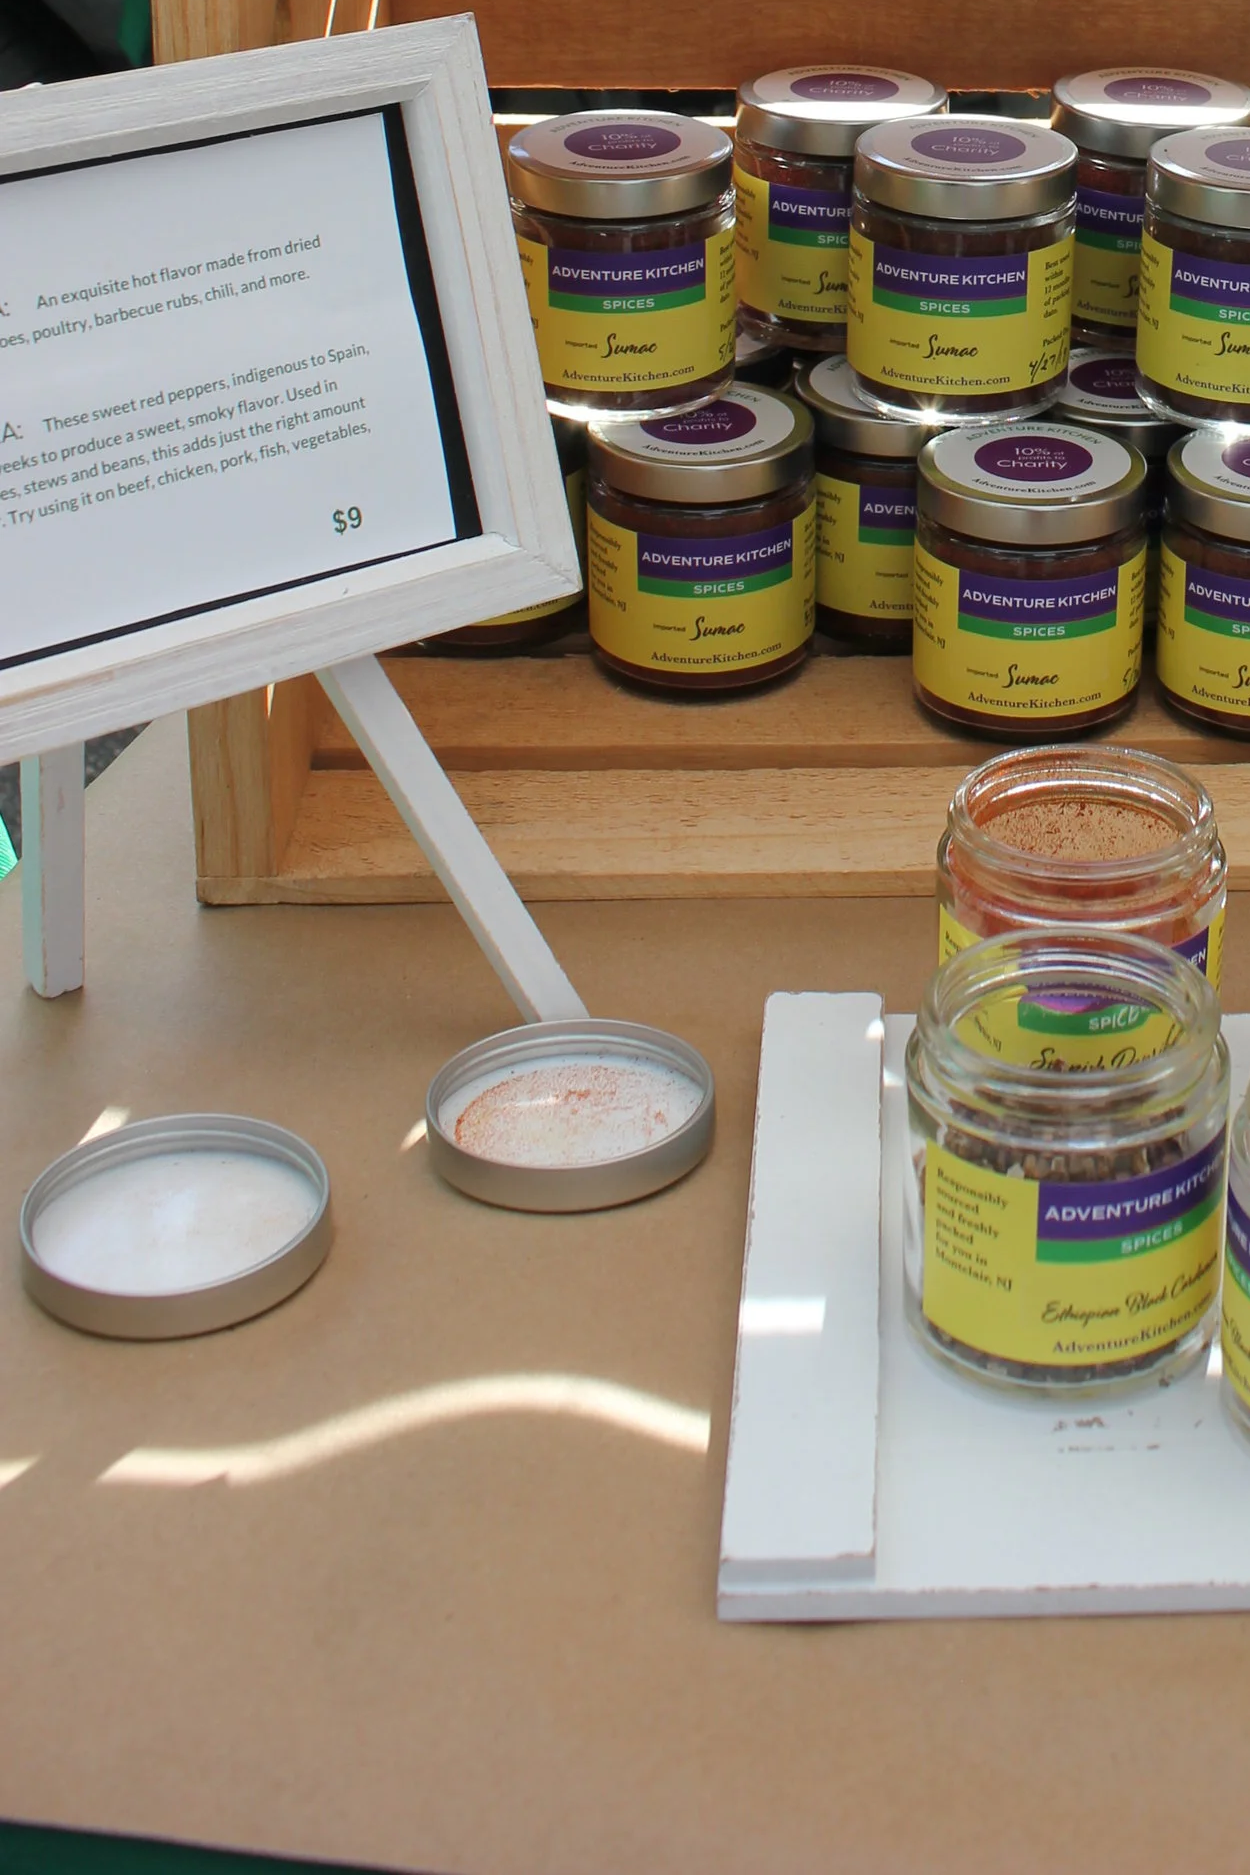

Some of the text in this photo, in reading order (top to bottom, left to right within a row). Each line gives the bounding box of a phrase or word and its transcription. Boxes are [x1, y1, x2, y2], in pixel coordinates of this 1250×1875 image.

[37, 234, 321, 309] An exquisite hot flavor made from dried
[876, 262, 1025, 286] ADVENTURE KITCHEN
[32, 319, 92, 344] poultry,
[94, 303, 163, 326] barbecue
[166, 293, 202, 310] rubs,
[205, 283, 238, 301] chili,
[241, 276, 267, 293] and
[269, 271, 310, 287] more.
[919, 301, 970, 314] SPICES
[923, 334, 978, 360] Sumac
[880, 366, 1011, 386] AdventureKitchen.com
[0, 344, 369, 444] A: These sweet red peppers, indigenous to Spain,
[0, 380, 338, 475] eeks to produce a sweet, smoky flavor. Used in
[24, 475, 67, 494] stews
[71, 463, 98, 482] and
[101, 455, 149, 474] beans,
[152, 444, 179, 461] this
[183, 435, 216, 454] adds
[218, 427, 246, 448] just
[248, 422, 273, 436] the
[276, 411, 310, 430] right
[313, 397, 366, 421] amount
[1015, 447, 1050, 456] 10%
[7, 423, 371, 524] Try using it on beef, chicken, pork, fish, vegetables,
[997, 459, 1068, 470] Charity
[332, 505, 363, 536] $9
